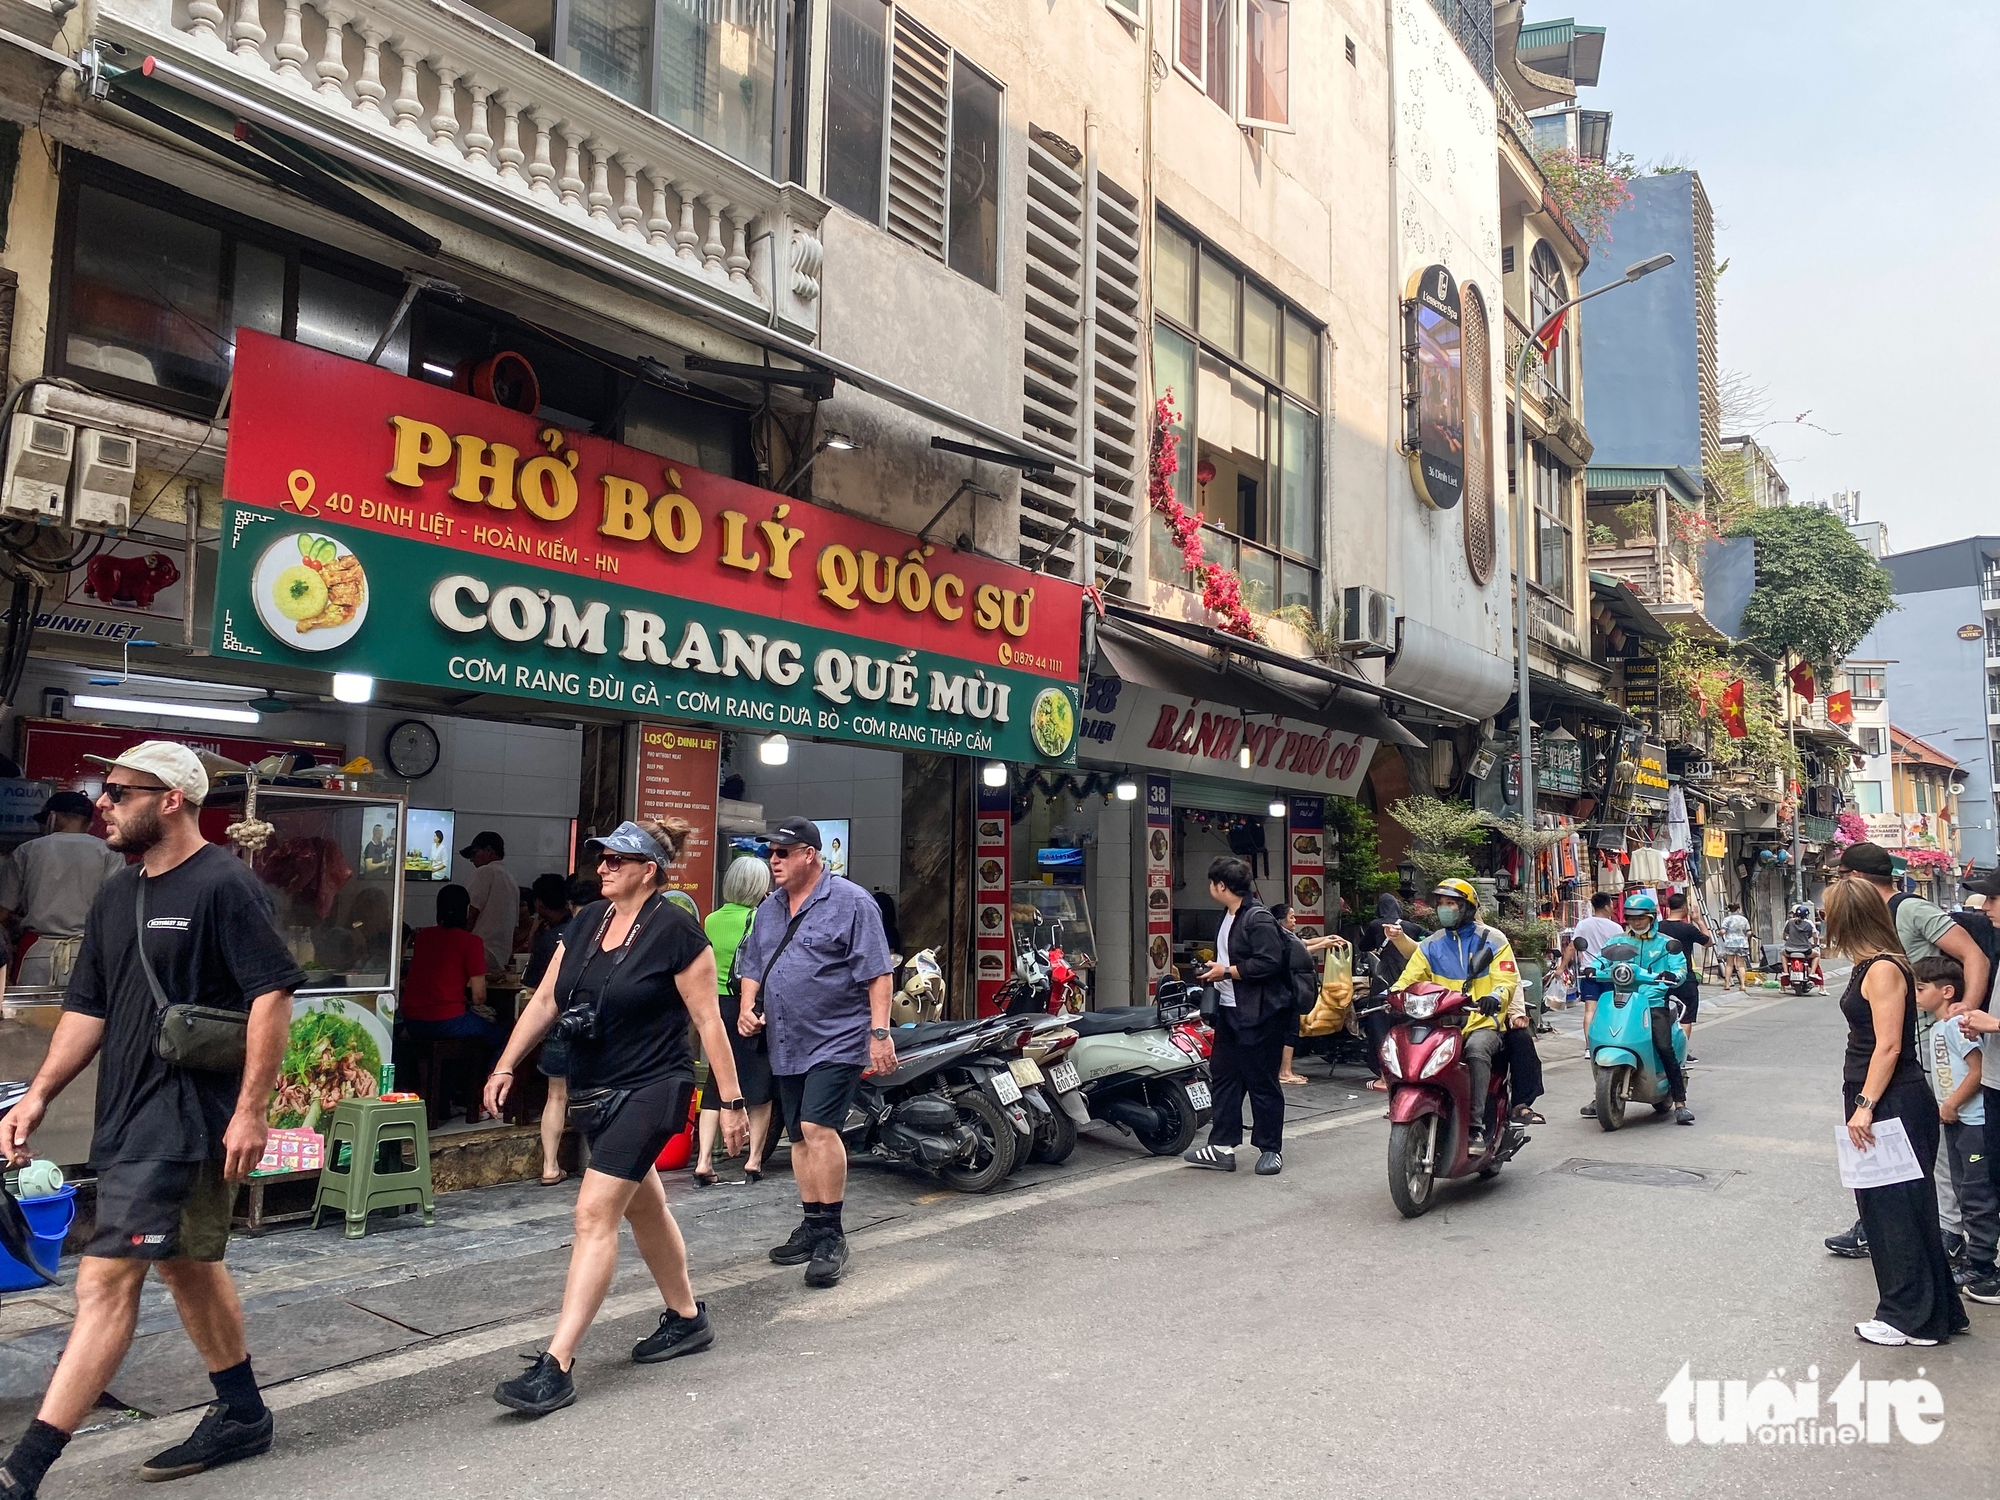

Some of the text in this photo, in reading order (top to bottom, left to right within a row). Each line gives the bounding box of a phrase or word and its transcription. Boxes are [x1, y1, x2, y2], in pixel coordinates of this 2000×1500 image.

[1447, 305, 1457, 320] Spa
[1428, 466, 1434, 477] 36
[325, 492, 353, 514] 40
[359, 499, 414, 529] ĐINH
[419, 512, 455, 540] LIỆT
[473, 526, 532, 554] HOÀN
[536, 537, 578, 565] KIẾM
[595, 553, 619, 574] HN
[386, 415, 1035, 637] PHỞ BÒ LÝ QUỐC SƯ
[92, 621, 143, 642] LIỆT
[430, 575, 1012, 723] CƠM RANG QUẾ MÙI
[1014, 650, 1063, 673] 0879 44 1111
[1627, 665, 1657, 674] MASSAGE
[448, 656, 506, 685] CƠM
[515, 666, 580, 695] RANG
[588, 673, 625, 701] ĐÙI
[631, 680, 660, 706] GÀ
[676, 691, 721, 715] CƠM
[725, 699, 774, 722] RANG
[779, 704, 813, 727] DƯA
[817, 707, 840, 730] BÒ
[852, 715, 886, 737] CƠM
[889, 721, 926, 743] RANG
[930, 727, 962, 749] THẬP
[965, 728, 993, 751] CẨM
[1081, 673, 1122, 714] 38
[1147, 698, 1242, 760] BÁNH
[644, 732, 717, 752] LQS 40 ĐINH LIỆT
[1688, 762, 1710, 774] 30
[3, 787, 45, 798] AQUA
[1150, 785, 1166, 803] 38
[624, 923, 641, 946] Canon
[1934, 1033, 1950, 1066] JUST
[1090, 1063, 1121, 1078] EVO
[1937, 1067, 1954, 1089] DO
[1056, 1073, 1080, 1092] 800.56
